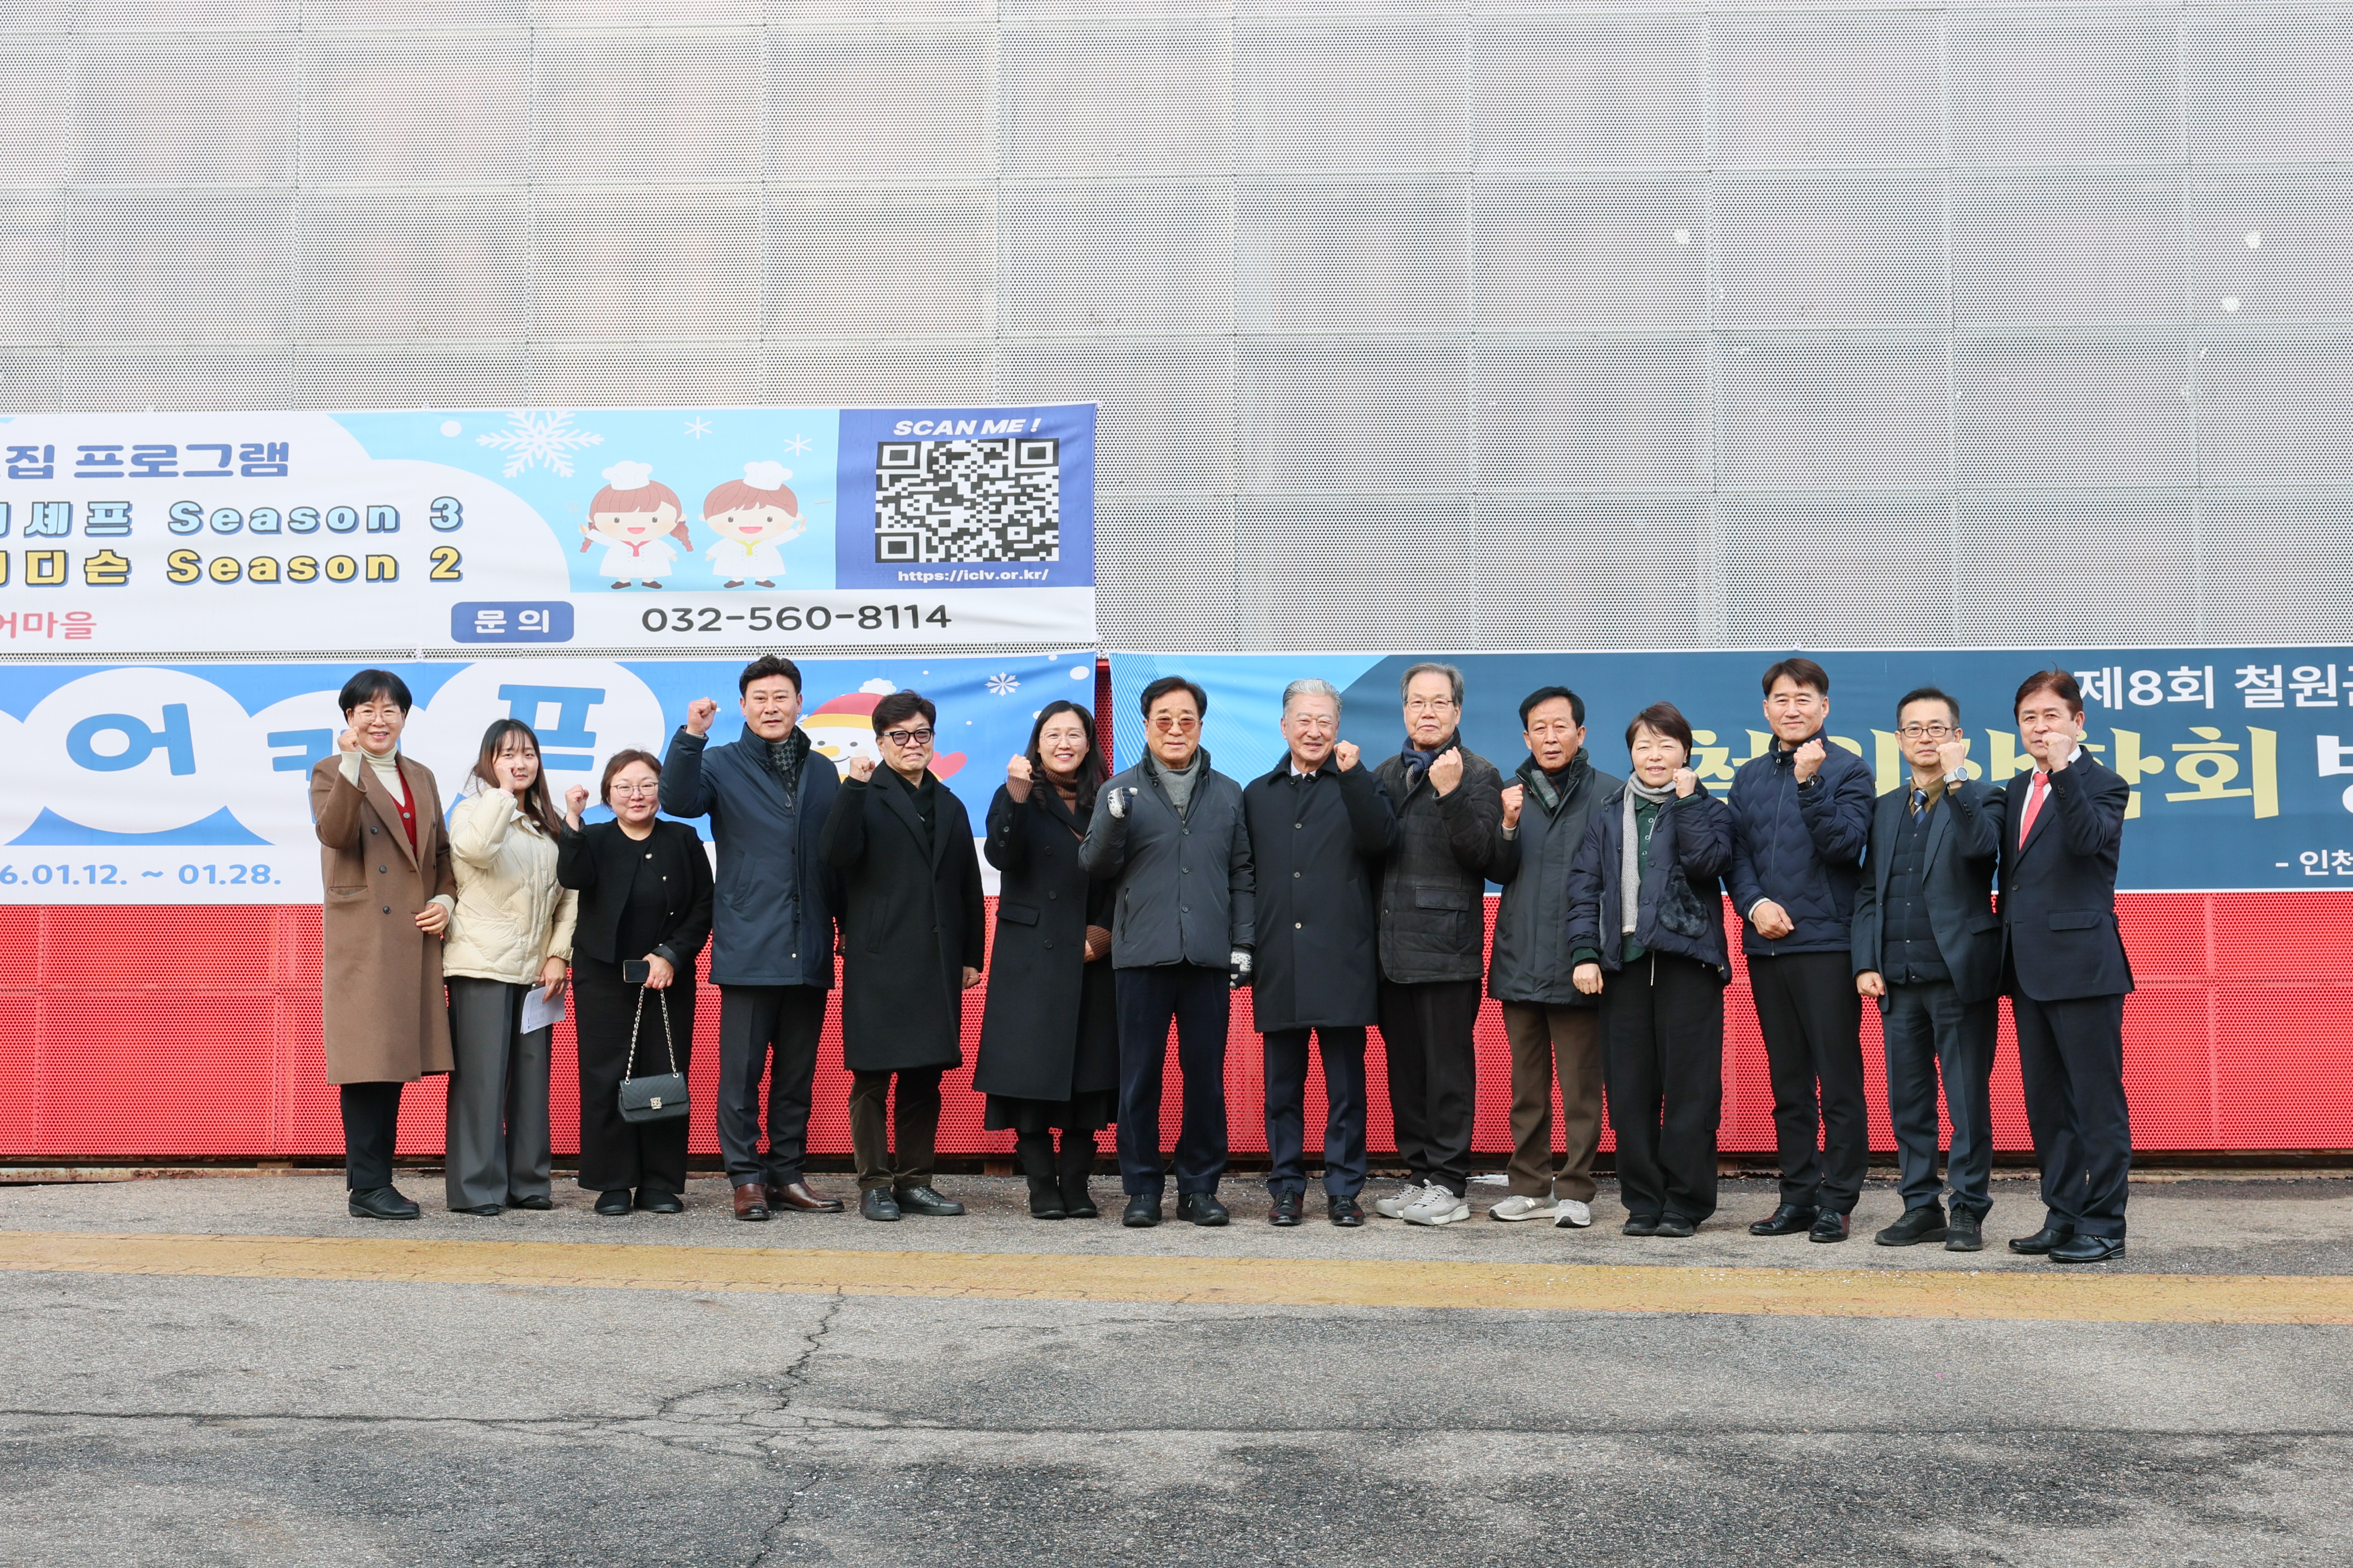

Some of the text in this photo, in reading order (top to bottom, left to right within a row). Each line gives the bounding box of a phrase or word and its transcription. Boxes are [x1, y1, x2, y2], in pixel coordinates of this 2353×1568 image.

[893, 420, 978, 436] SCAN
[981, 419, 1027, 435] ME
[74, 442, 289, 478] 프로그램
[0, 496, 464, 538] 셰프 Season 3
[0, 546, 463, 588] 디슨 Season 2
[898, 569, 1049, 583] https://iclv.or.kr/
[642, 605, 952, 633] 032-560-8114
[2073, 664, 2353, 710] 제8회 철원
[178, 864, 281, 885] 01.28.
